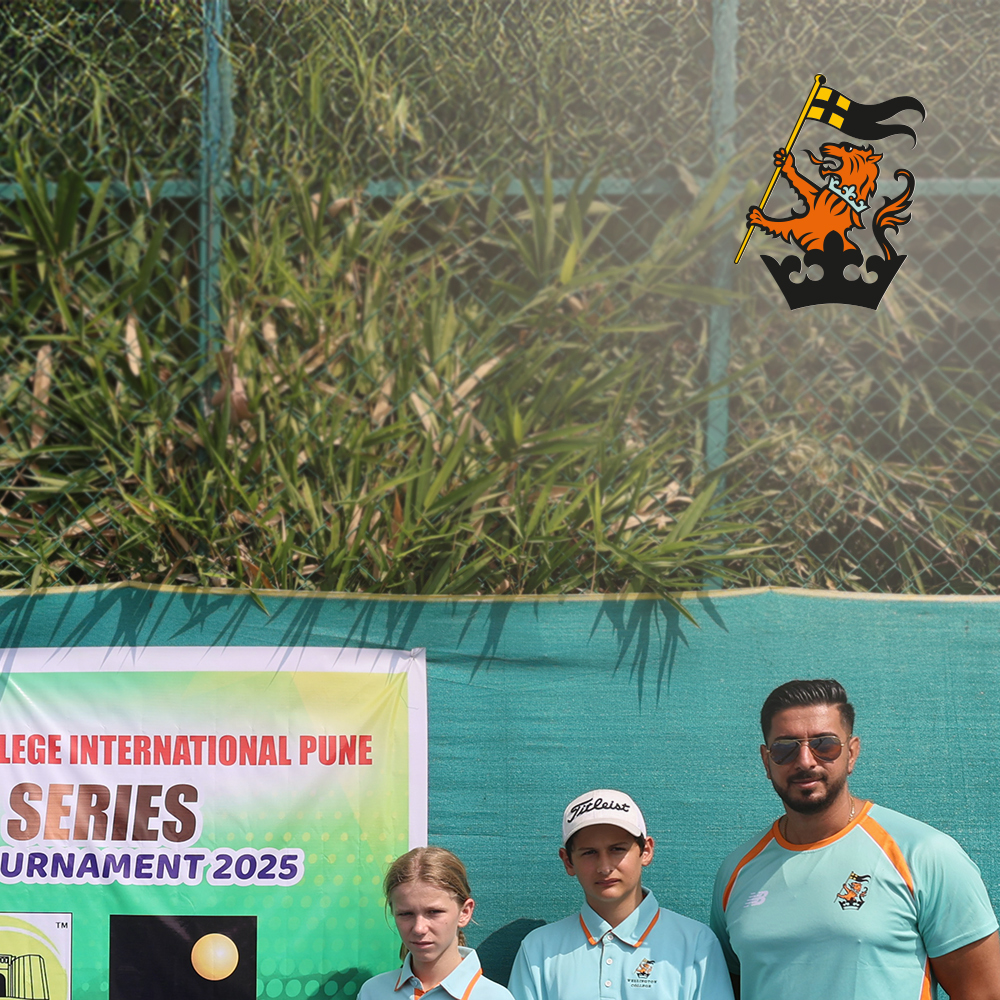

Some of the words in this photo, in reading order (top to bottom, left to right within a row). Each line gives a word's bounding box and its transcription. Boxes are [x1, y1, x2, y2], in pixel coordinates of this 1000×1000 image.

[69, 734, 292, 766] INTERNATIONAL
[299, 734, 373, 766] PUNE
[7, 783, 199, 843] SERIES
[567, 797, 631, 823] Titleist
[212, 853, 299, 881] 2025
